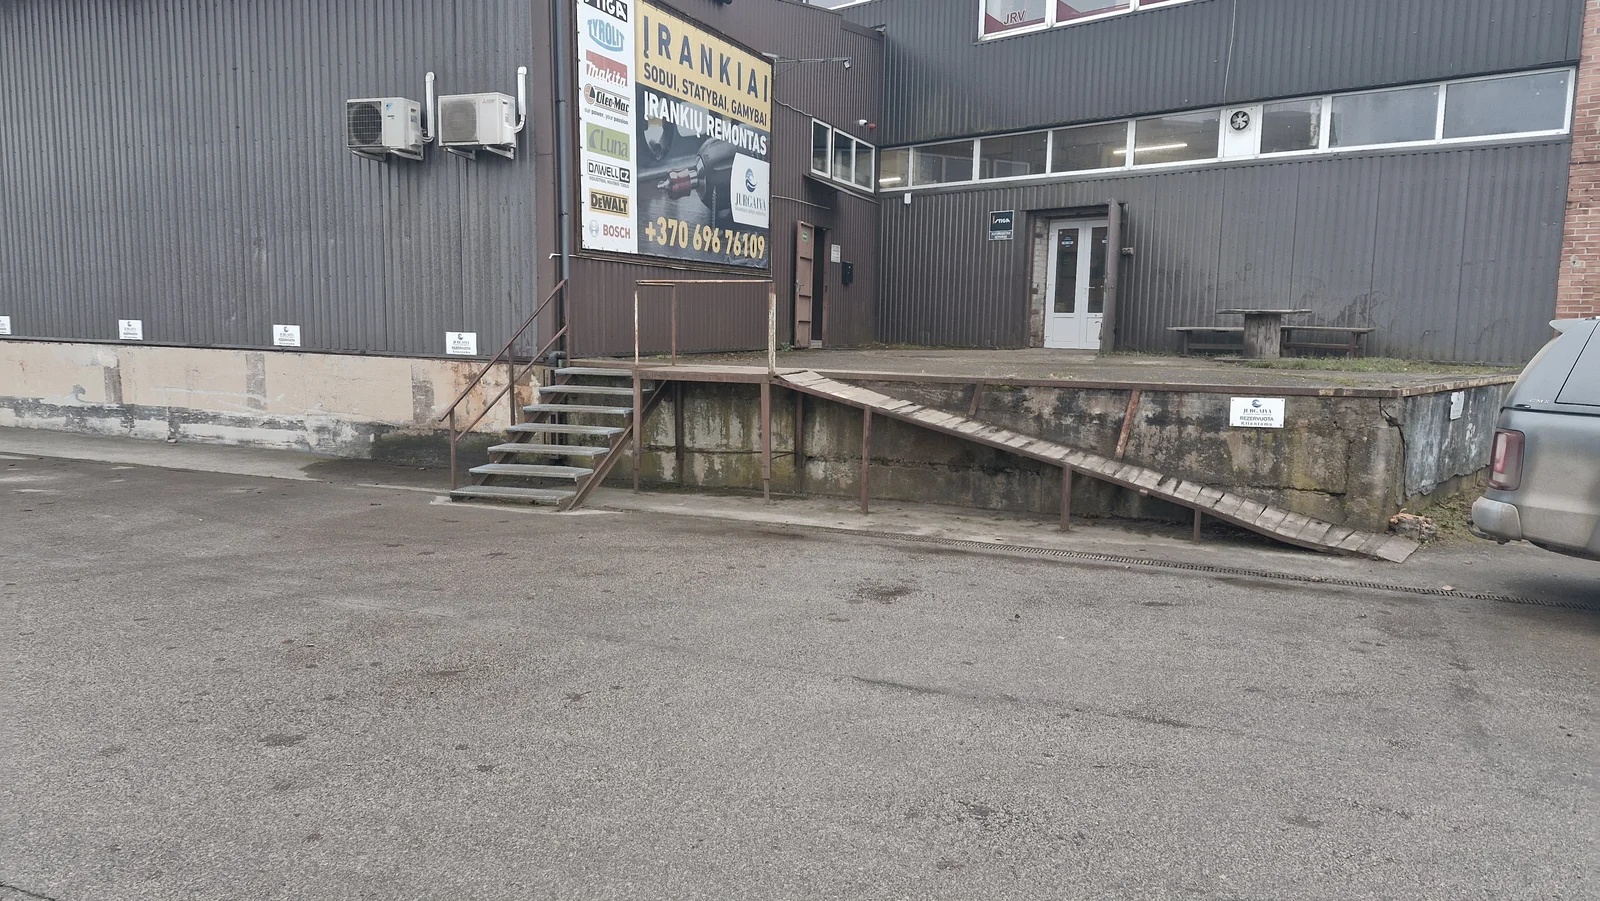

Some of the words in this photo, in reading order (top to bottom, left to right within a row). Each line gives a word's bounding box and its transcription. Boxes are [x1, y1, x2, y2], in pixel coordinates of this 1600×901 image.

[1003, 10, 1026, 25] JRV
[587, 19, 625, 49] TYROLIT
[643, 15, 768, 103] ĮRANKIAI
[596, 91, 629, 113] Oleo-Mac
[644, 62, 679, 93] SODUI,
[682, 78, 729, 113] STATYBAI,
[731, 99, 767, 127] GAMYBAI
[644, 90, 703, 138] ĮRANKIŲ
[706, 114, 767, 155] REMONTAS
[600, 130, 628, 158] Luna
[589, 162, 619, 179] DAWELL
[603, 224, 631, 239] BOSCH
[645, 216, 688, 249] +370
[693, 223, 721, 253] 696
[725, 229, 765, 259] 76109
